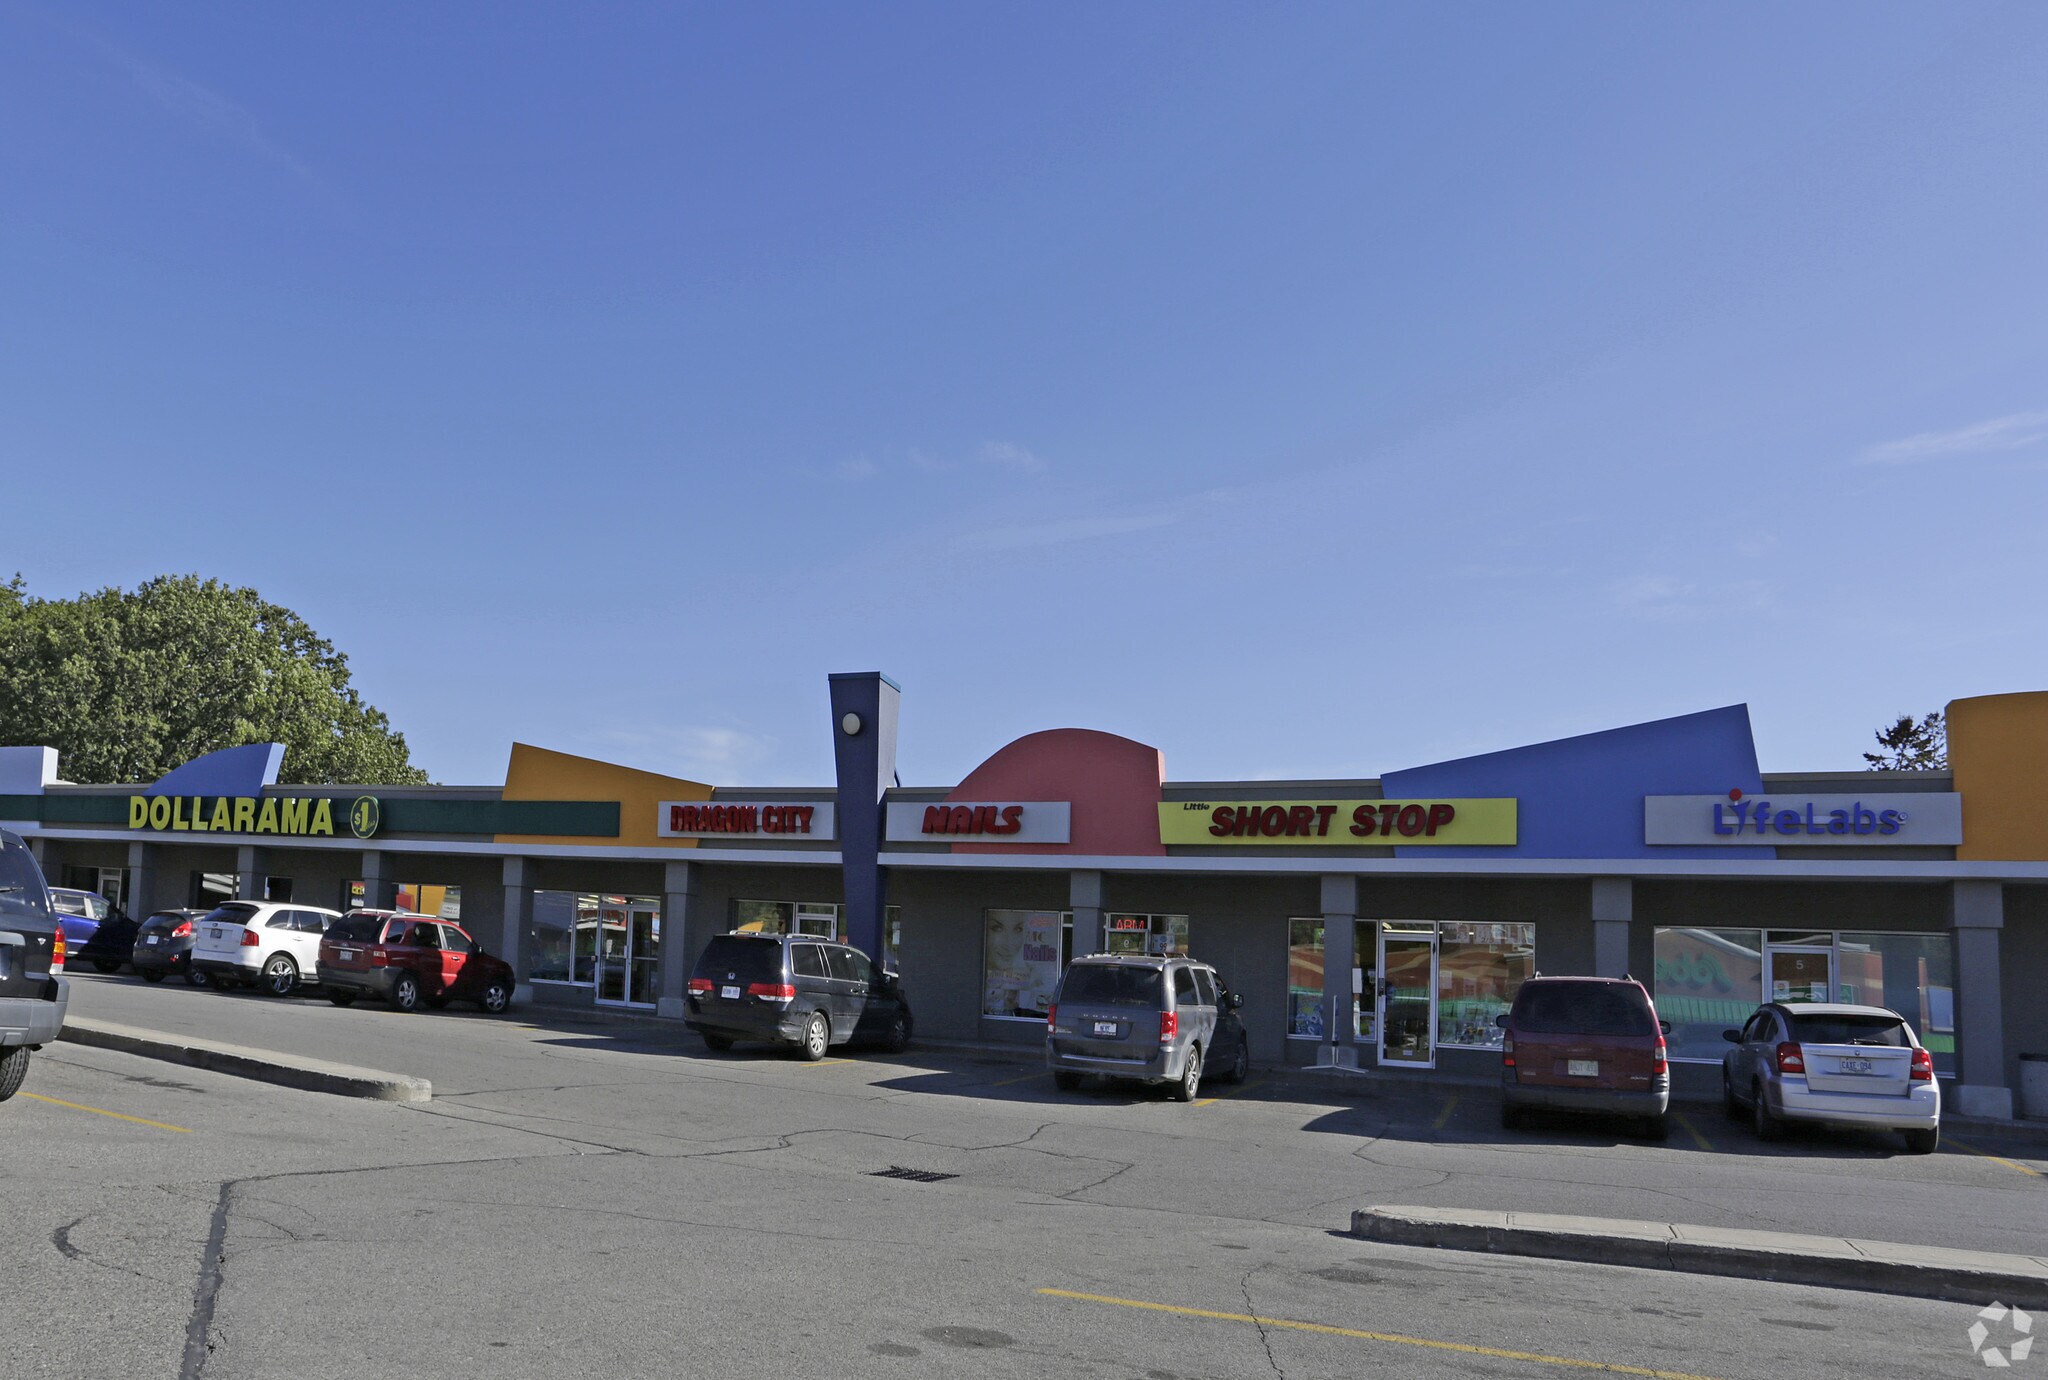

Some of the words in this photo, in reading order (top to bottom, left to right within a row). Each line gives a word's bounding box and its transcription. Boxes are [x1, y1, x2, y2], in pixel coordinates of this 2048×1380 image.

[129, 795, 334, 836] DOLLARAMA
[671, 805, 757, 833] DRAGON
[762, 805, 814, 833] CITY
[922, 805, 1024, 835] NAILS
[1183, 803, 1210, 811] Little
[1208, 805, 1338, 837] SHORT
[1349, 804, 1455, 837] STOP
[1713, 790, 1900, 836] LifeLabs
[1023, 944, 1057, 962] Nails
[1796, 959, 1804, 970] 5
